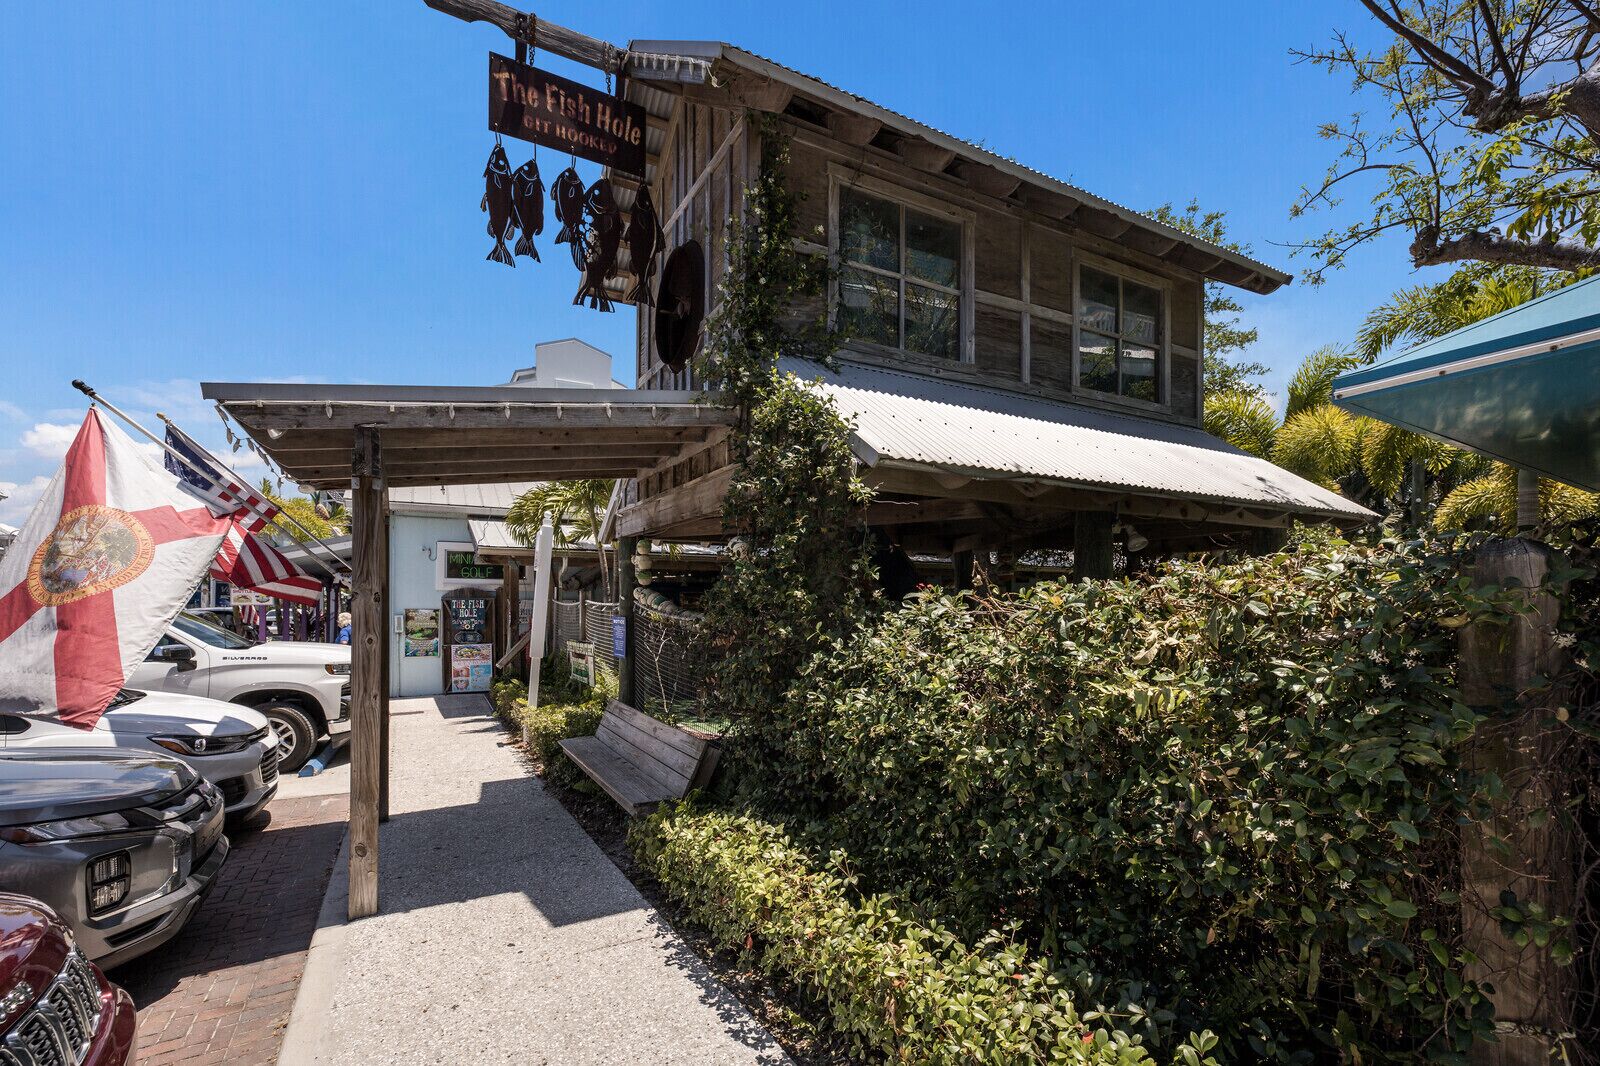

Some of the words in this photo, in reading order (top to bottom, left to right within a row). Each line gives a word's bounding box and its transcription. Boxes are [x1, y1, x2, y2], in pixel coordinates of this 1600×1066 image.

[493, 71, 539, 108] The
[545, 82, 591, 125] Fish
[597, 102, 642, 146] Hole
[555, 123, 617, 154] HOOKED
[460, 566, 493, 578] GOLF
[452, 599, 466, 608] THE
[468, 599, 485, 608] FISH
[459, 608, 478, 618] HOLE
